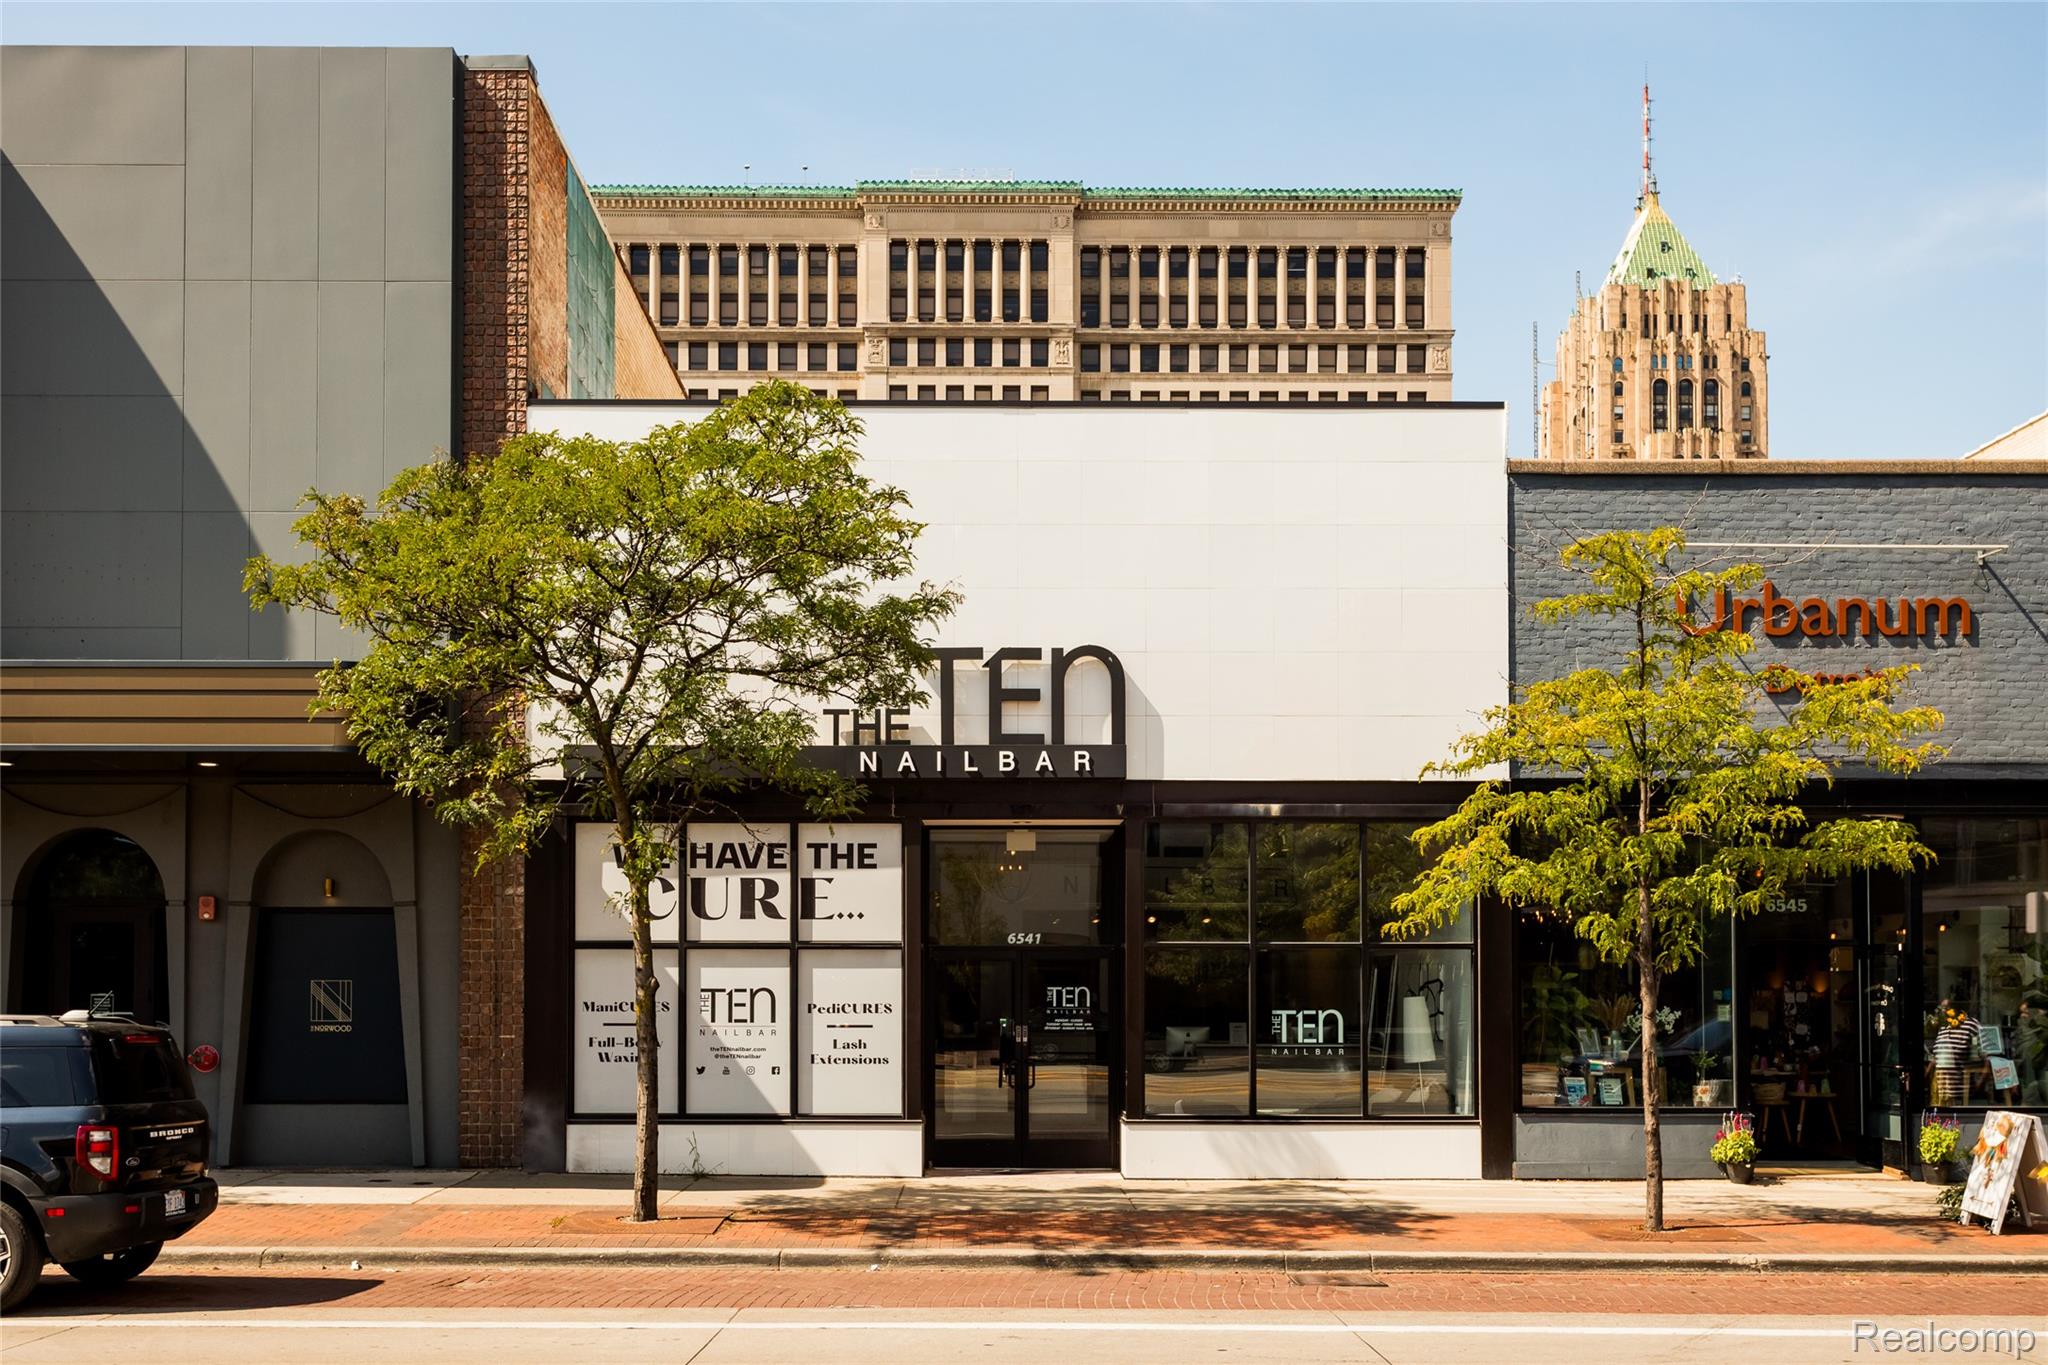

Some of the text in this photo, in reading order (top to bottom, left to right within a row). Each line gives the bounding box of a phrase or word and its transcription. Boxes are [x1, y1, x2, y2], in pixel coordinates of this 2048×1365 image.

[1675, 579, 1973, 637] Urbanum
[823, 708, 911, 746] THE
[860, 750, 1091, 773] NAILBAR
[690, 842, 788, 869] HAVE
[806, 842, 878, 869] THE
[1765, 898, 1808, 913] 6545
[1007, 932, 1042, 945] 6541
[583, 1001, 670, 1013] ManiCS
[700, 993, 710, 1015] THE
[807, 1002, 893, 1015] PediCURES
[1271, 1015, 1281, 1035] THE
[700, 1029, 777, 1037] NAILBAR
[588, 1036, 664, 1050] Full-By
[833, 1038, 868, 1050] Lash
[598, 1052, 639, 1064] Waxi
[810, 1053, 890, 1065] Extensions
[149, 1127, 194, 1138] BRONCO
